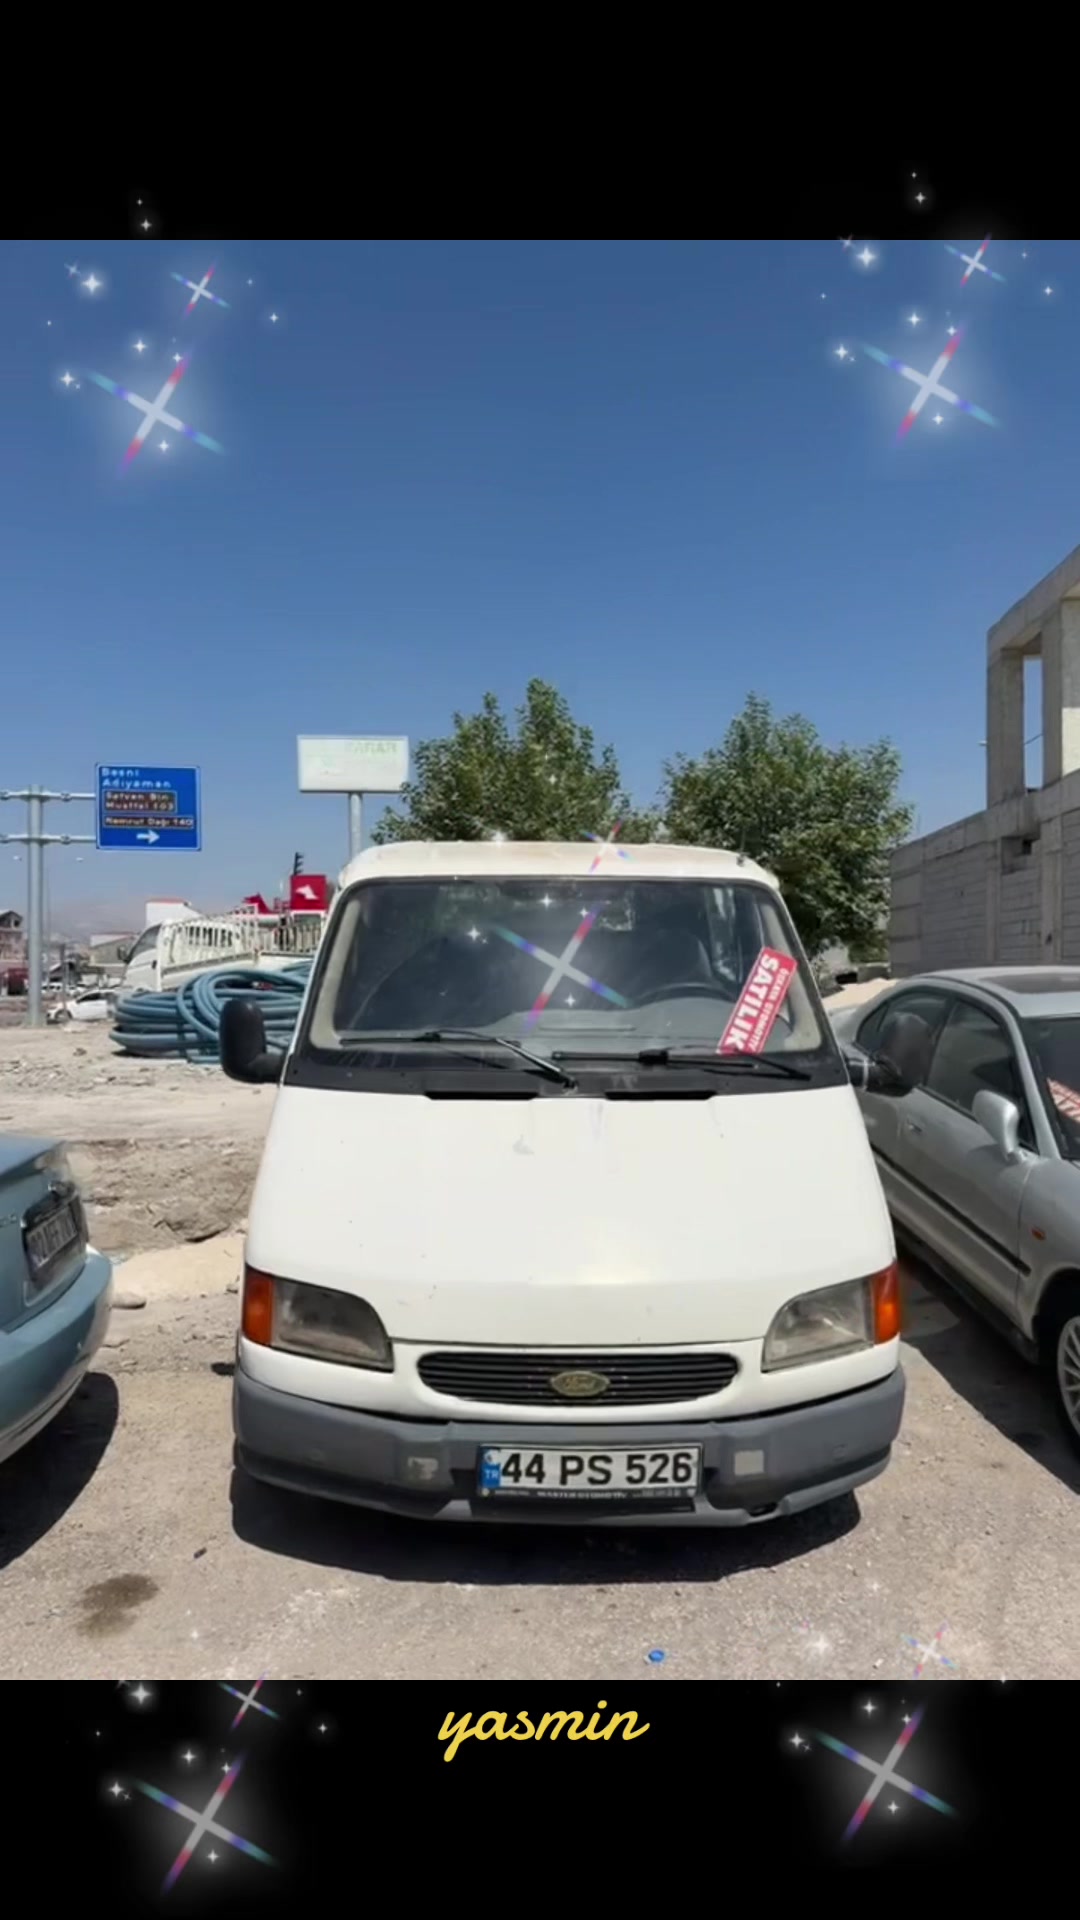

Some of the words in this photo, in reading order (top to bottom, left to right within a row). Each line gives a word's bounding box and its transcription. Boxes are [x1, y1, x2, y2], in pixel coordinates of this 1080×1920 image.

[101, 768, 140, 777] Besni
[725, 954, 779, 1051] SATILIK
[485, 1469, 499, 1479] TR
[502, 1452, 545, 1484] 44
[560, 1454, 613, 1486] PS
[625, 1452, 693, 1485] 526
